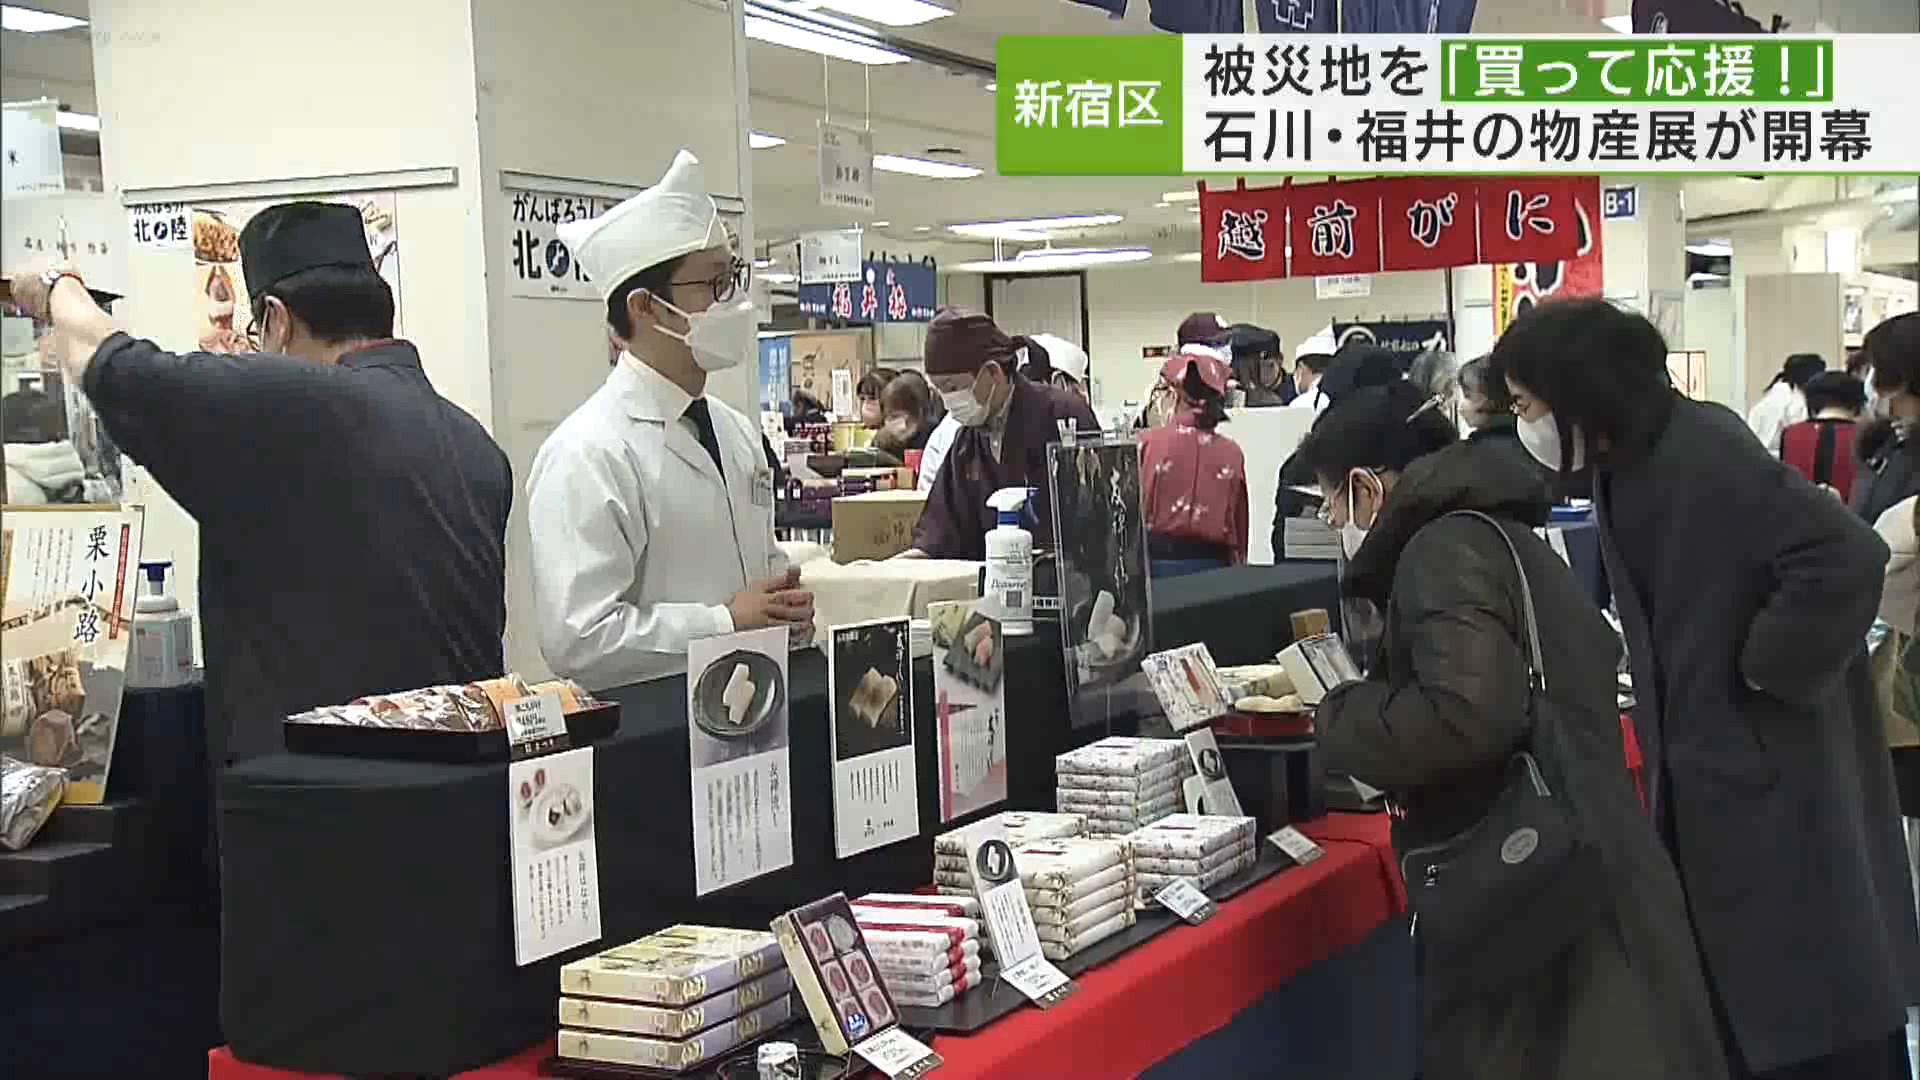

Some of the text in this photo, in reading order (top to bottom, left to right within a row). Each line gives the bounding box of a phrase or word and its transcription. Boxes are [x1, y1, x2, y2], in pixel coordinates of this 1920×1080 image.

[1217, 188, 1556, 262] 越前がに
[1604, 191, 1634, 215] B-1
[72, 524, 111, 643] 栗小路
